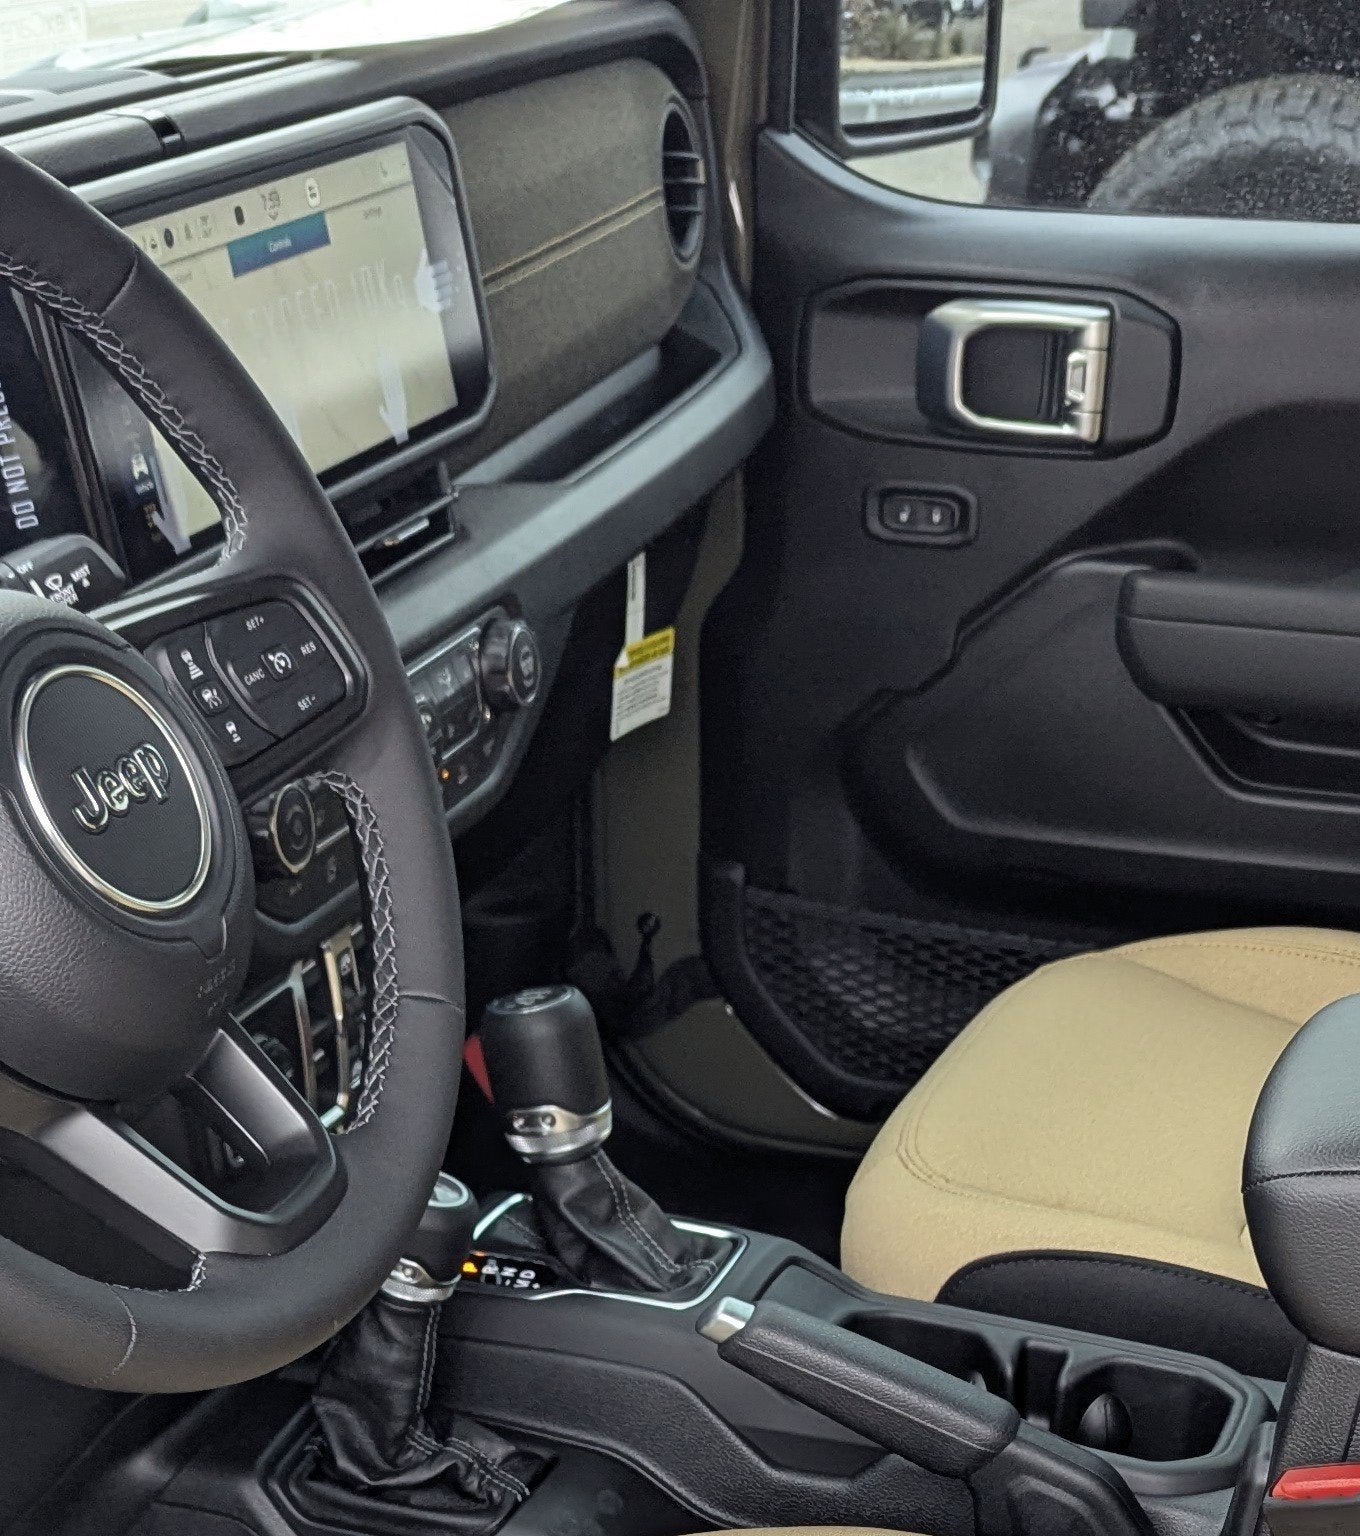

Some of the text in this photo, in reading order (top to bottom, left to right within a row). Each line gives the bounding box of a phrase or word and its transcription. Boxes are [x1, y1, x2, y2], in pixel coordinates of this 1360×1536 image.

[11, 500, 39, 530] DO
[244, 668, 265, 686] CANC
[71, 743, 170, 835] Jeep
